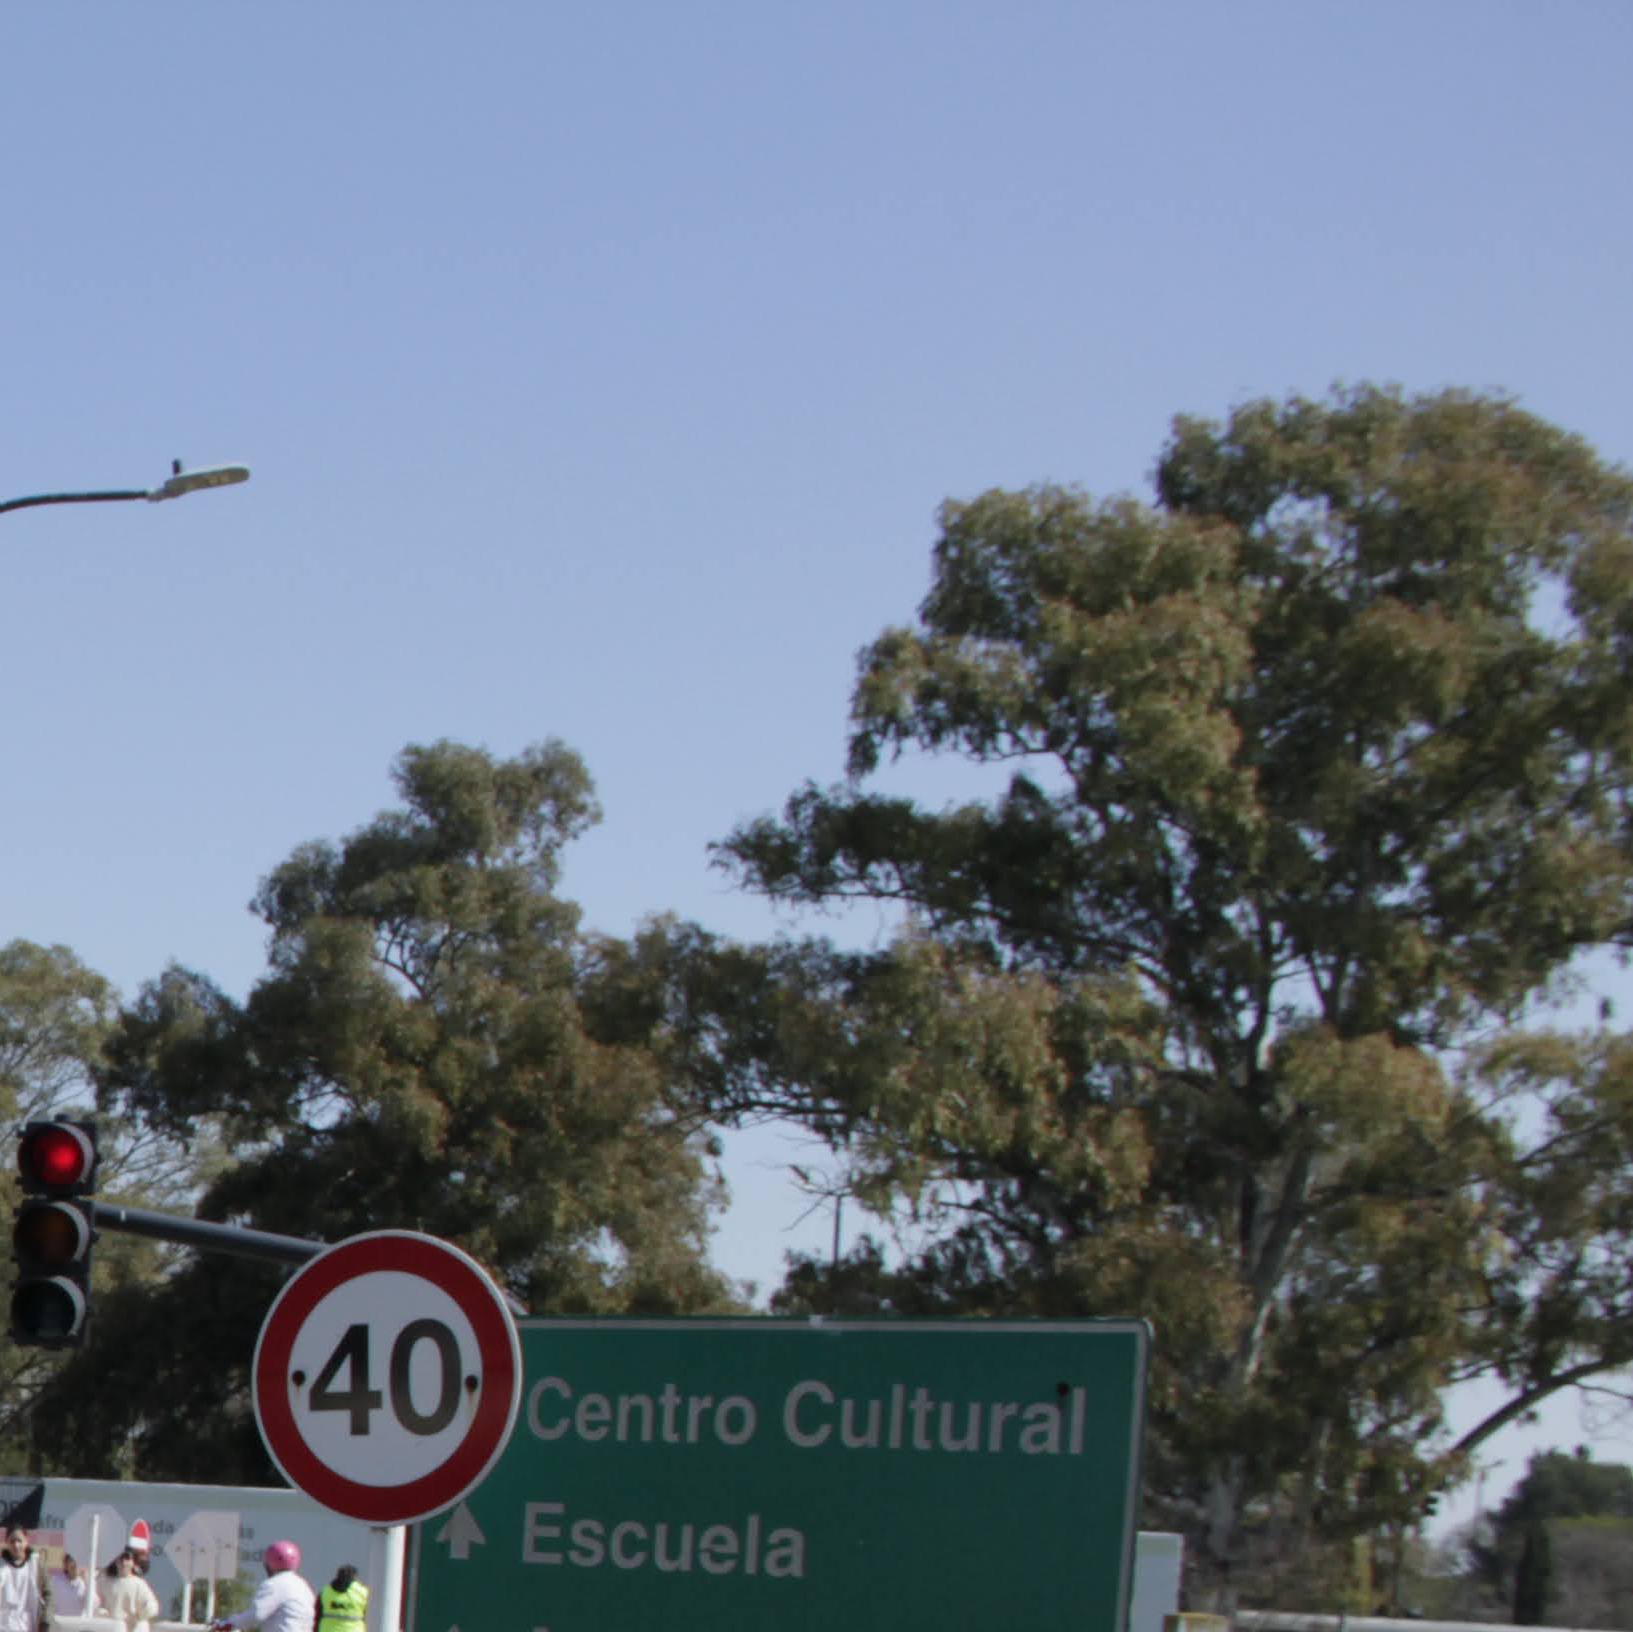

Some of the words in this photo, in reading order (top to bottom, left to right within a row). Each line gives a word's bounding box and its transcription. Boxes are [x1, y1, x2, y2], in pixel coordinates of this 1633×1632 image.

[308, 1320, 462, 1436] 40
[526, 1376, 756, 1447] Centro
[783, 1380, 1085, 1456] Cultural
[521, 1500, 805, 1578] Escuela
